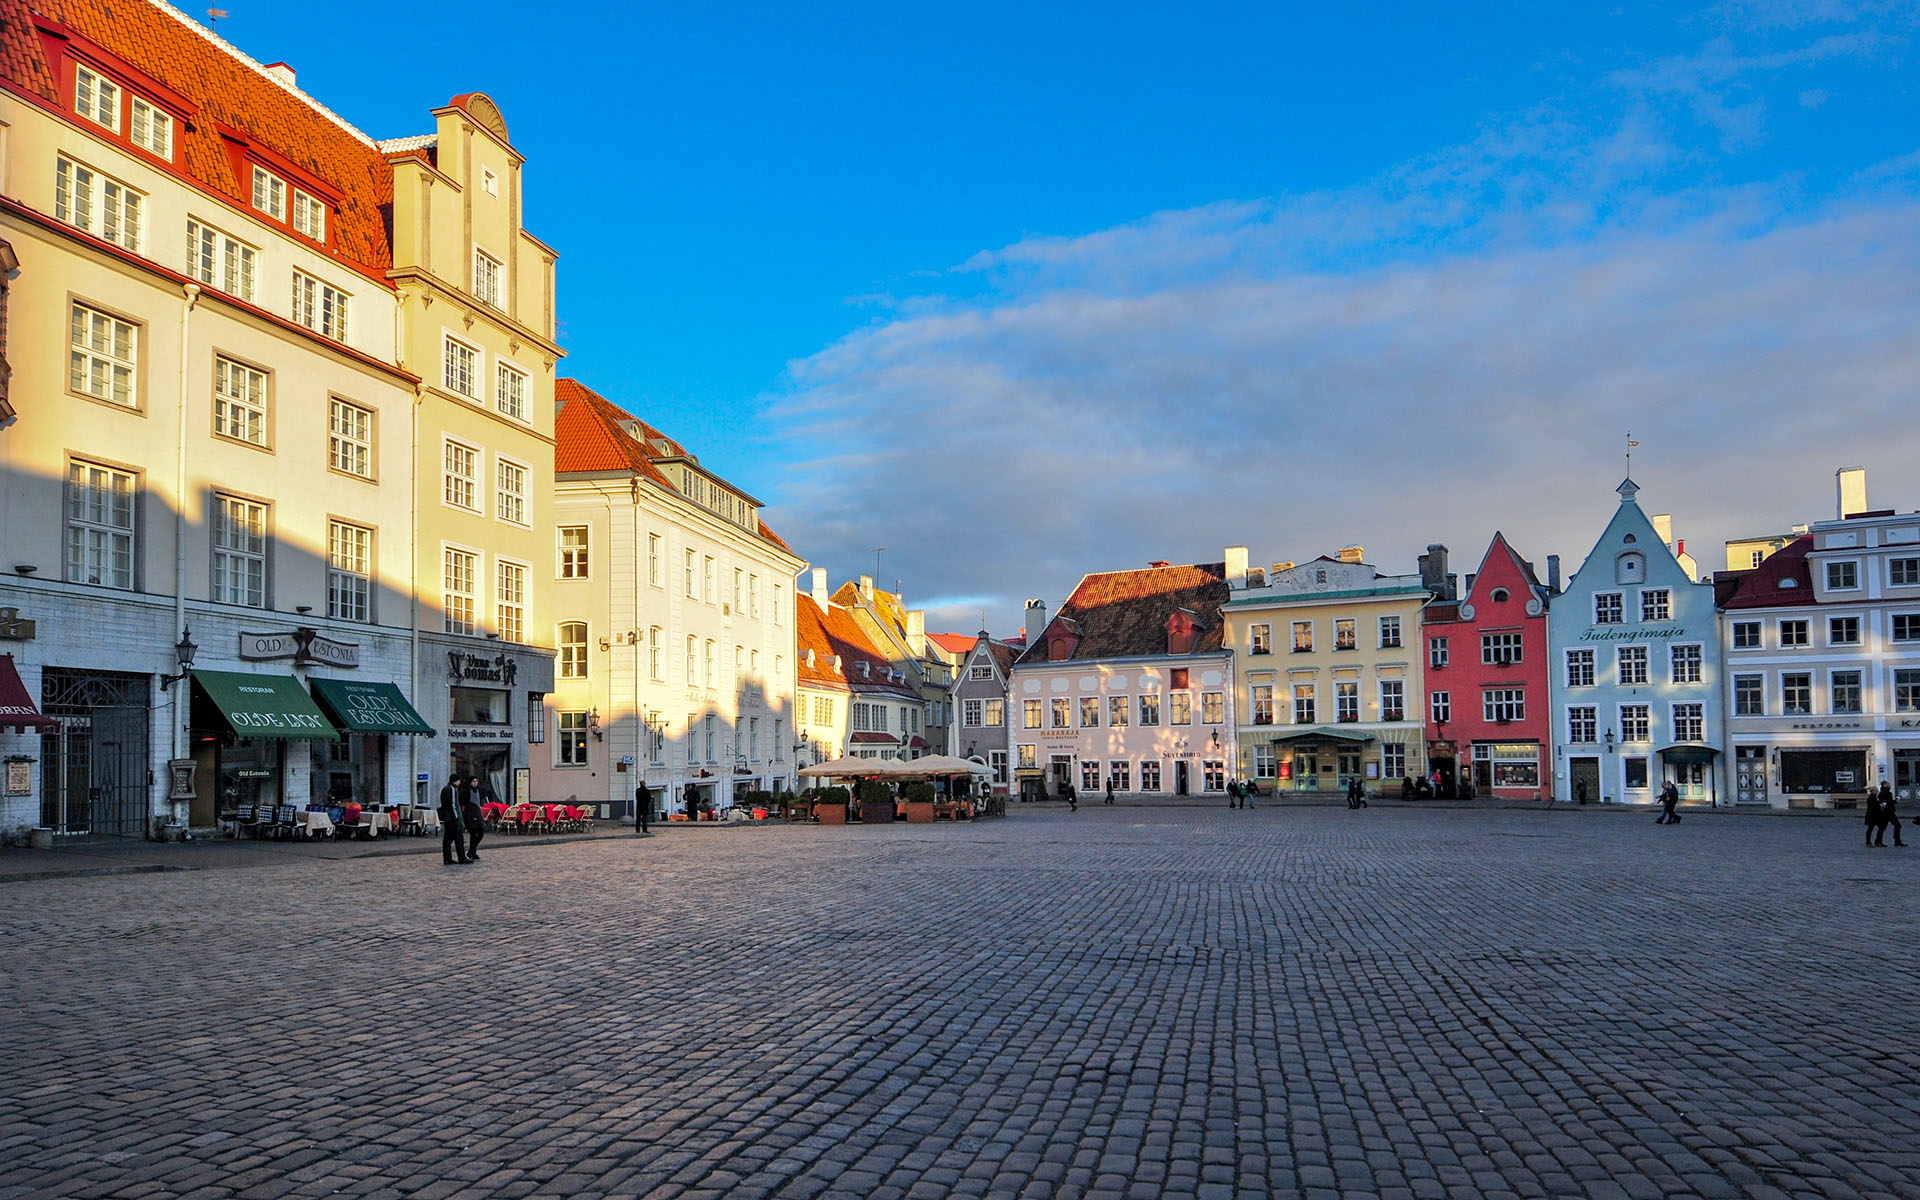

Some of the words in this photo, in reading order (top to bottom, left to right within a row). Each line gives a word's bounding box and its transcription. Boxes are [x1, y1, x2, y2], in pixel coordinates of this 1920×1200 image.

[1580, 627, 1689, 643] Tudengimaja
[313, 642, 355, 661] ESTONIA
[348, 694, 397, 711] OLDE
[231, 712, 284, 727] OLDE
[282, 713, 323, 728] INN
[347, 709, 420, 726] ESTONIA
